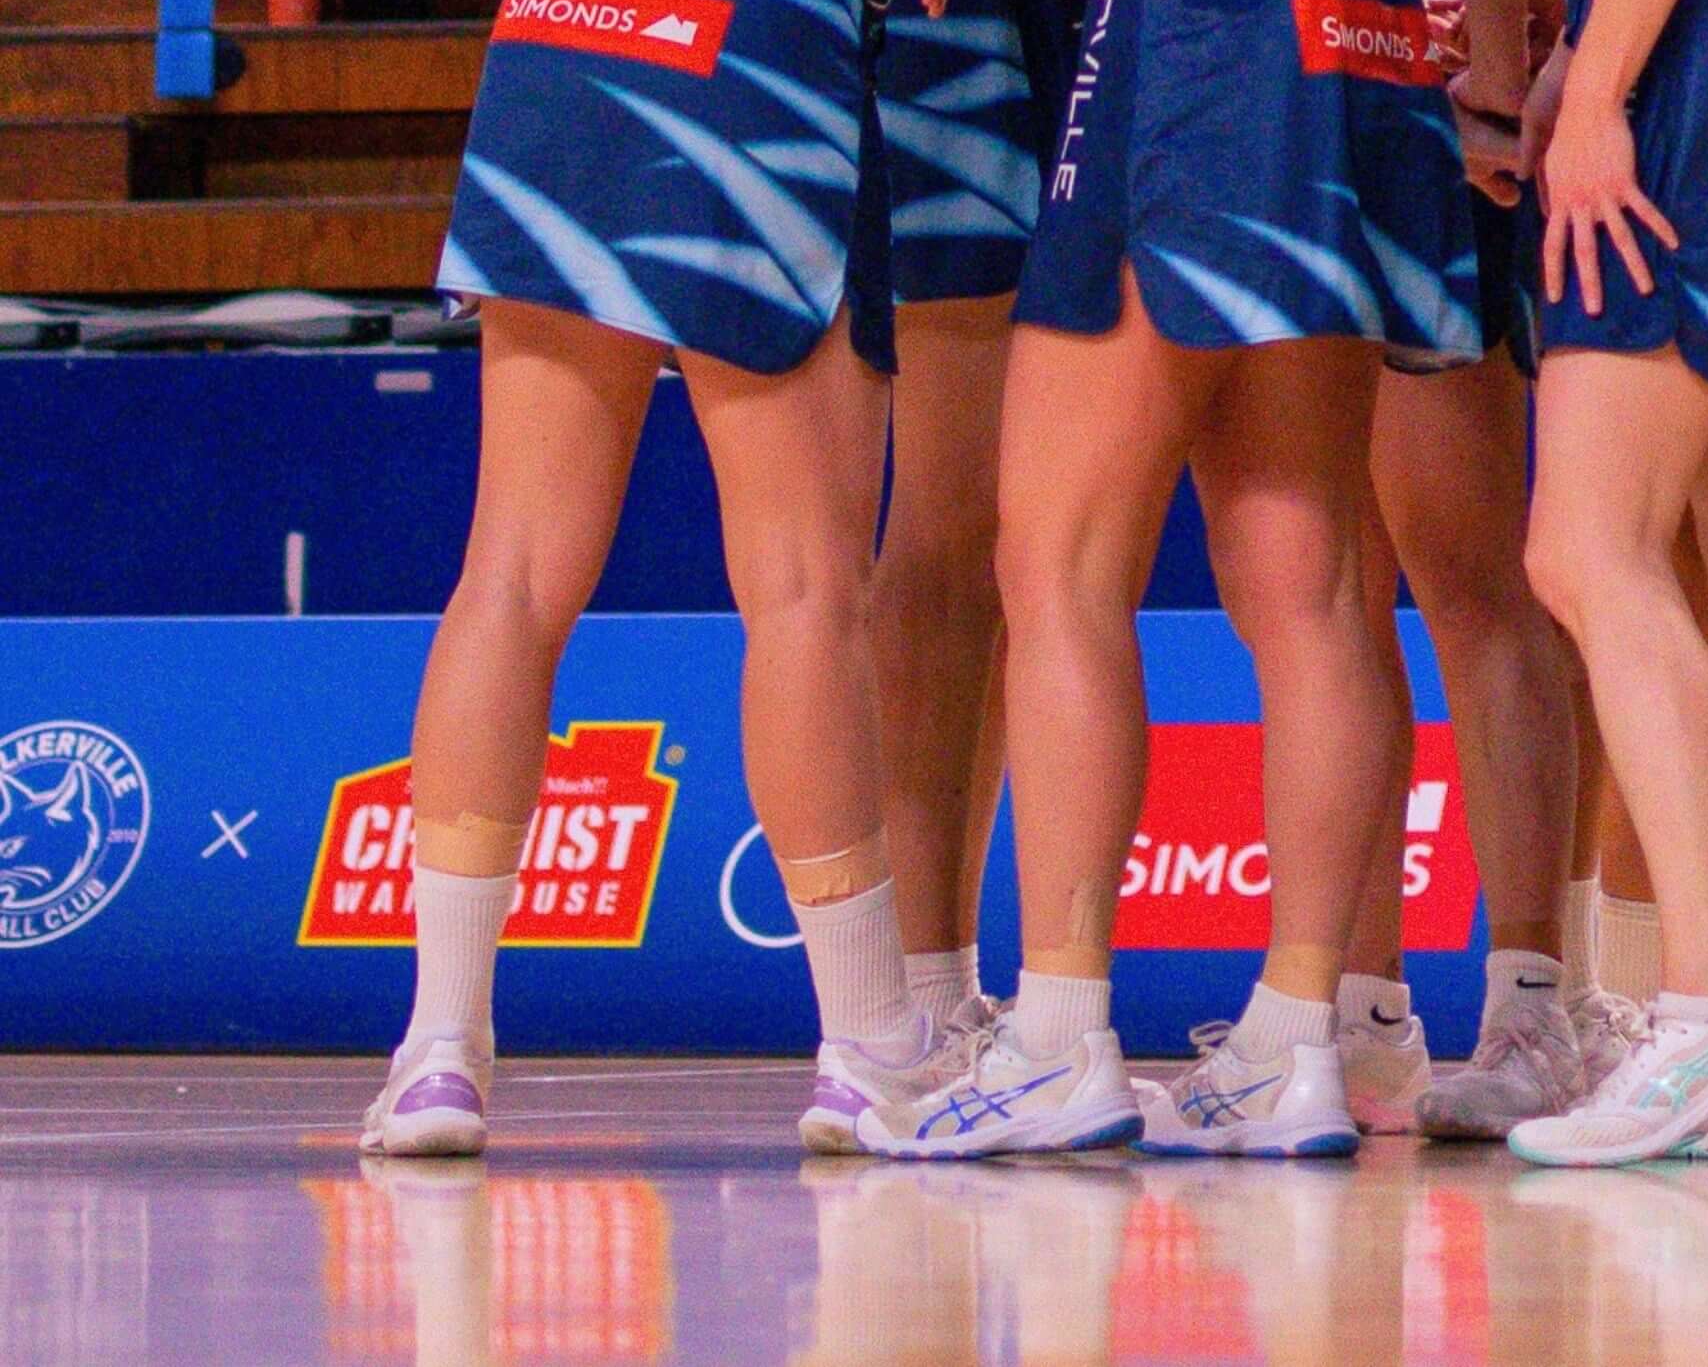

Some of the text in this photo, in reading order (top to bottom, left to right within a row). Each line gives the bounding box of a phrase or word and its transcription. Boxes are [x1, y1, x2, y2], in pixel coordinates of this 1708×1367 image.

[1320, 15, 1415, 64] SMONDS
[0, 730, 139, 800] LKERVILLE
[341, 803, 649, 871] CHIST
[1119, 833, 1434, 898] SIMOS
[43, 879, 107, 930] CLUB
[332, 880, 622, 915] WAUSE
